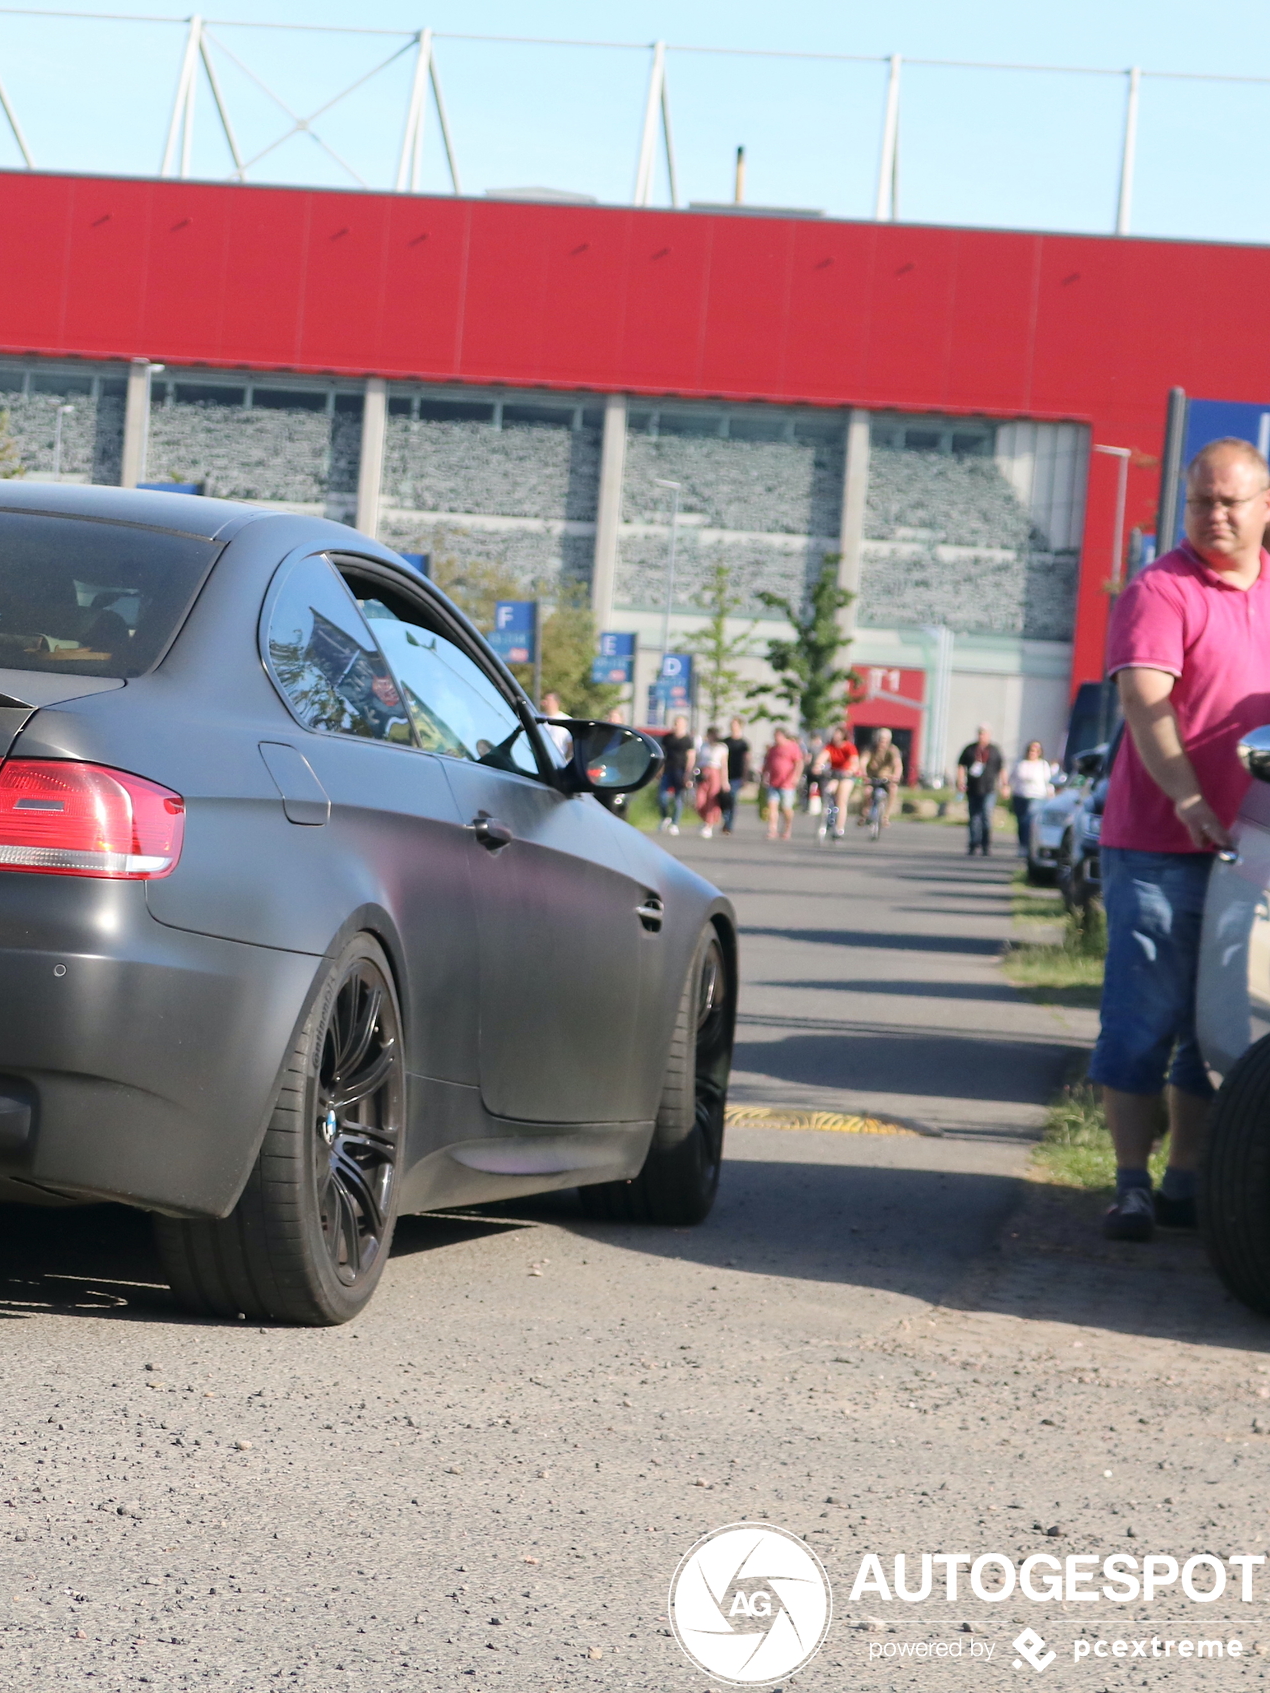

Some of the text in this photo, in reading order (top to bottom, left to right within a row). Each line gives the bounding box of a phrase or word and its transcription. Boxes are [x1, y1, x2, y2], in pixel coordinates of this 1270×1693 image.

[497, 606, 514, 629] F
[603, 636, 617, 656] E
[662, 657, 681, 677] D
